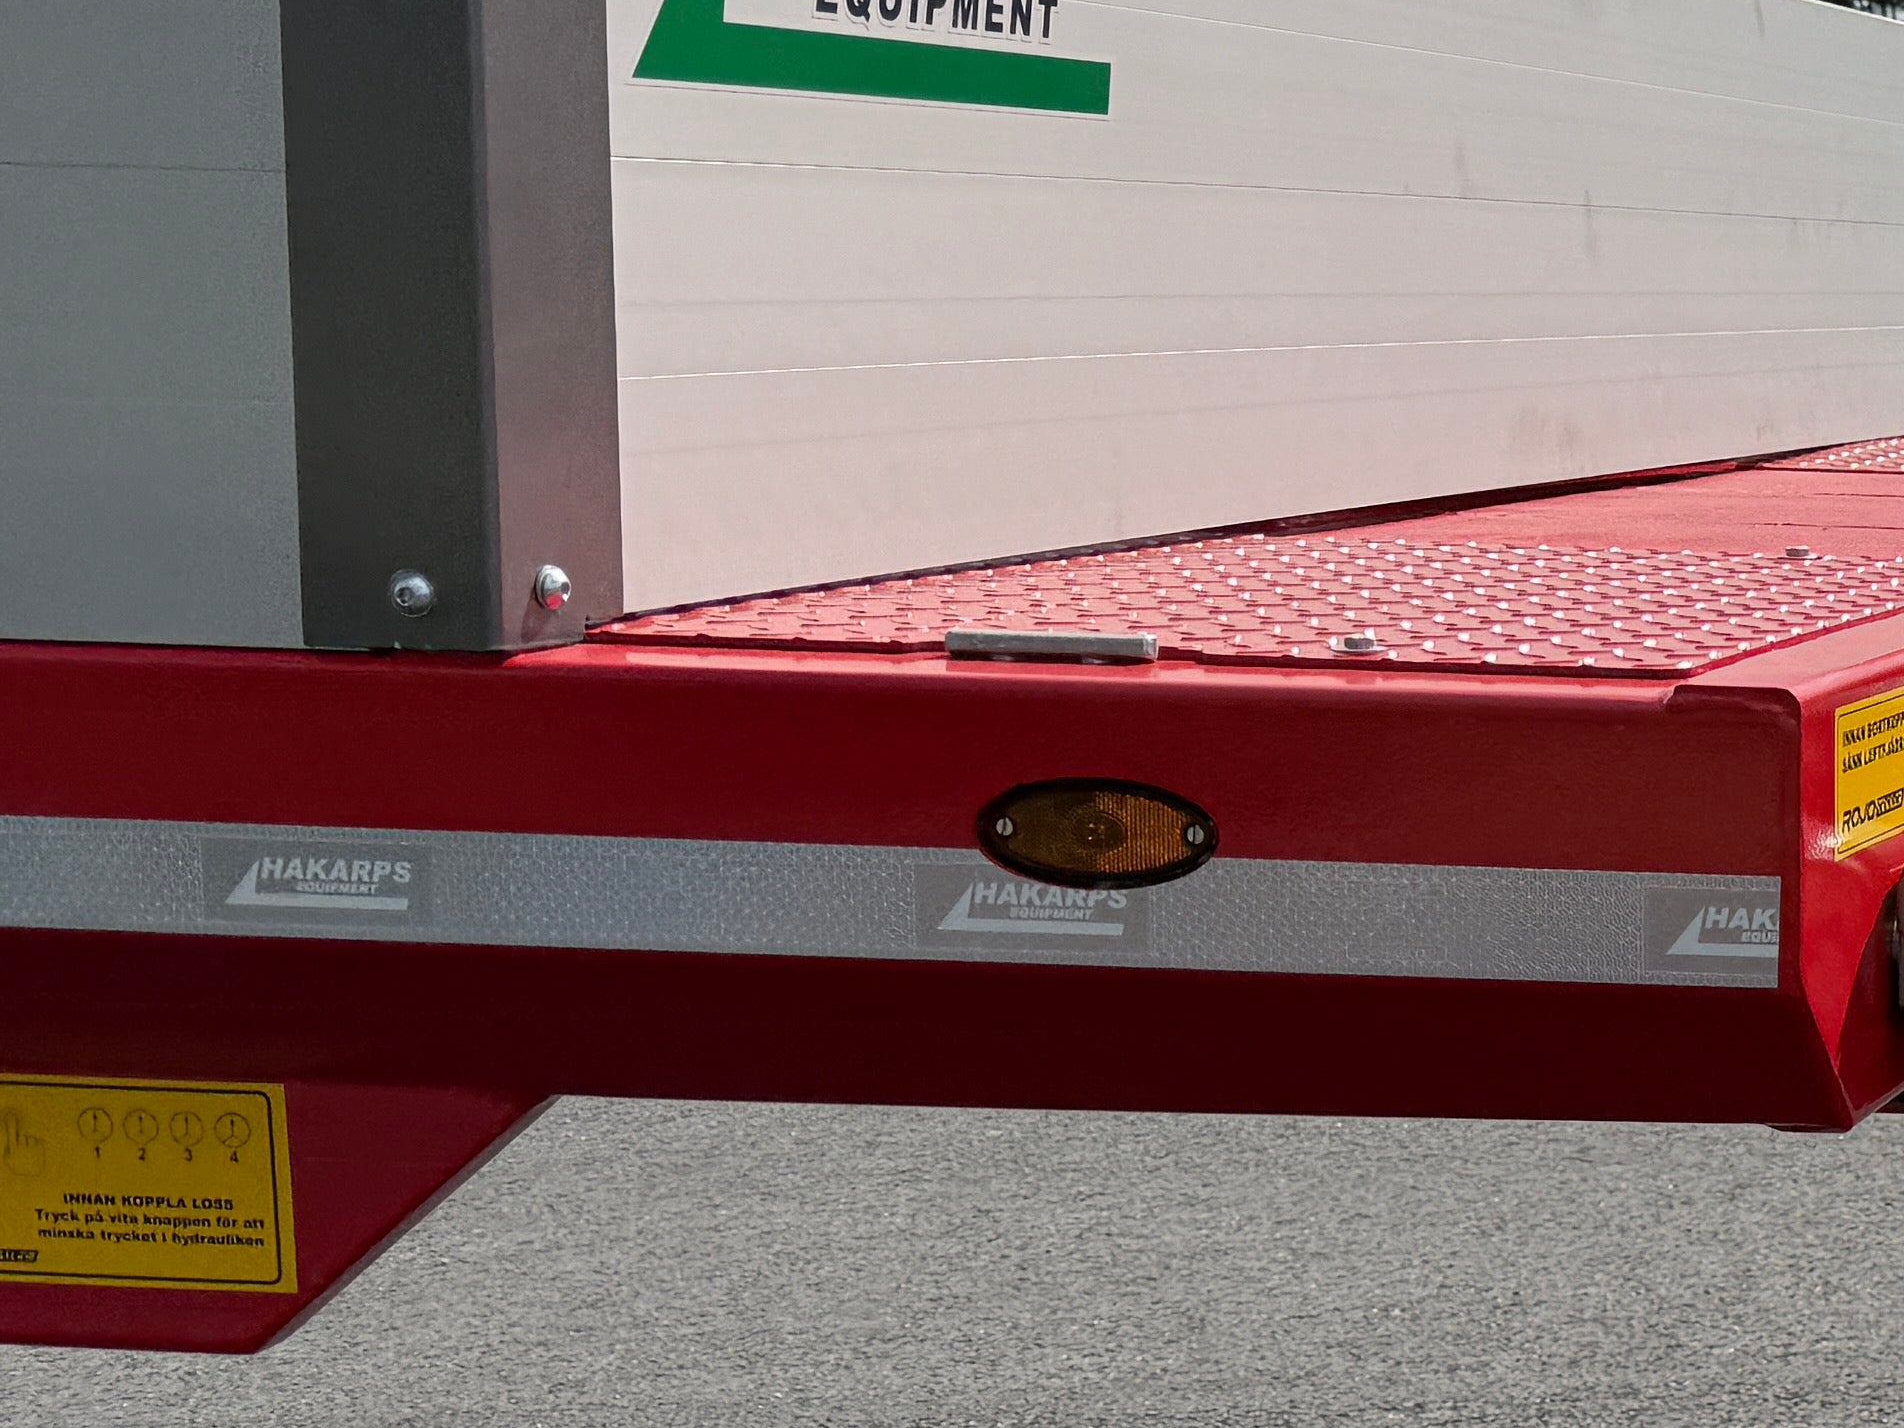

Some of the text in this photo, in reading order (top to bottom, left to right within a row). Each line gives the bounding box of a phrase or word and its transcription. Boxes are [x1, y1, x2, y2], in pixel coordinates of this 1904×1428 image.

[261, 857, 411, 883] HAKARPS
[296, 881, 377, 895] EQUIPMENT
[1010, 907, 1093, 921] EQUIPMENT
[94, 1147, 239, 1163] 1 2 3 4
[121, 1195, 187, 1209] KOPPLA
